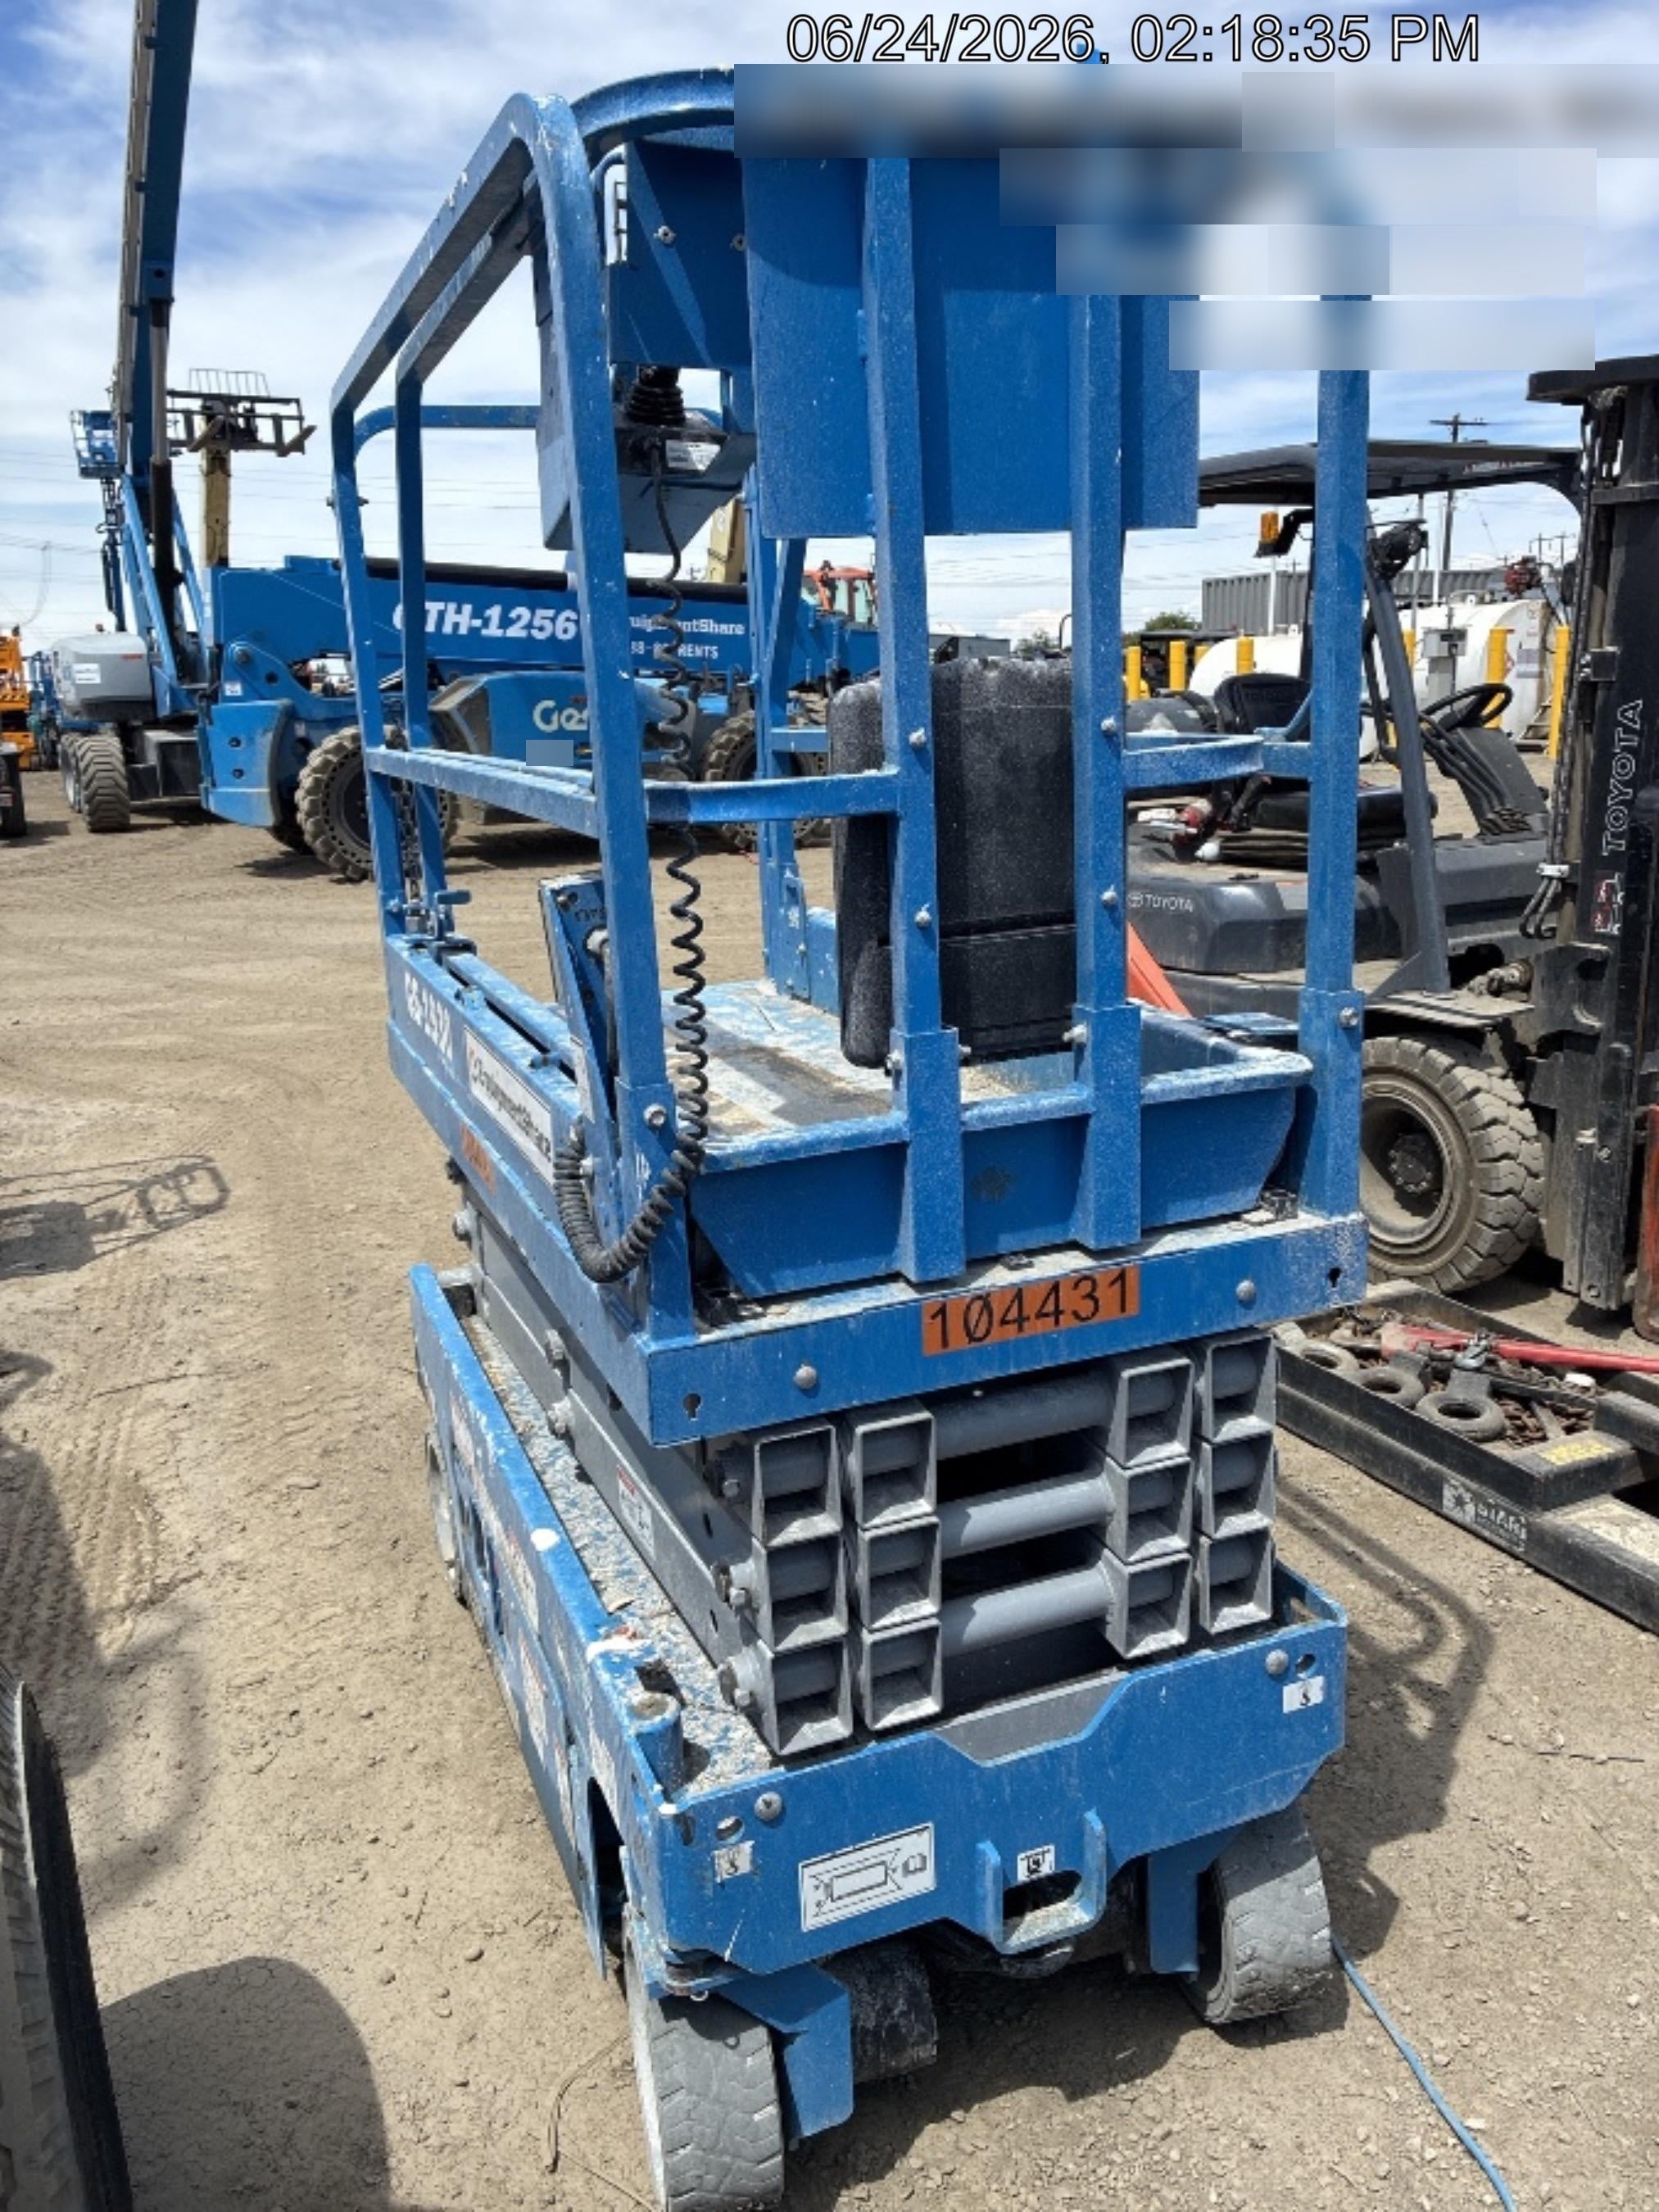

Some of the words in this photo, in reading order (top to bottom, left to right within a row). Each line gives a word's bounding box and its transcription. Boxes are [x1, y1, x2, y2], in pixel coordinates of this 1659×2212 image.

[1602, 698, 1643, 856] TOYOTA
[1145, 893, 1194, 913] TOYOTA
[930, 1267, 1127, 1350] 104431
